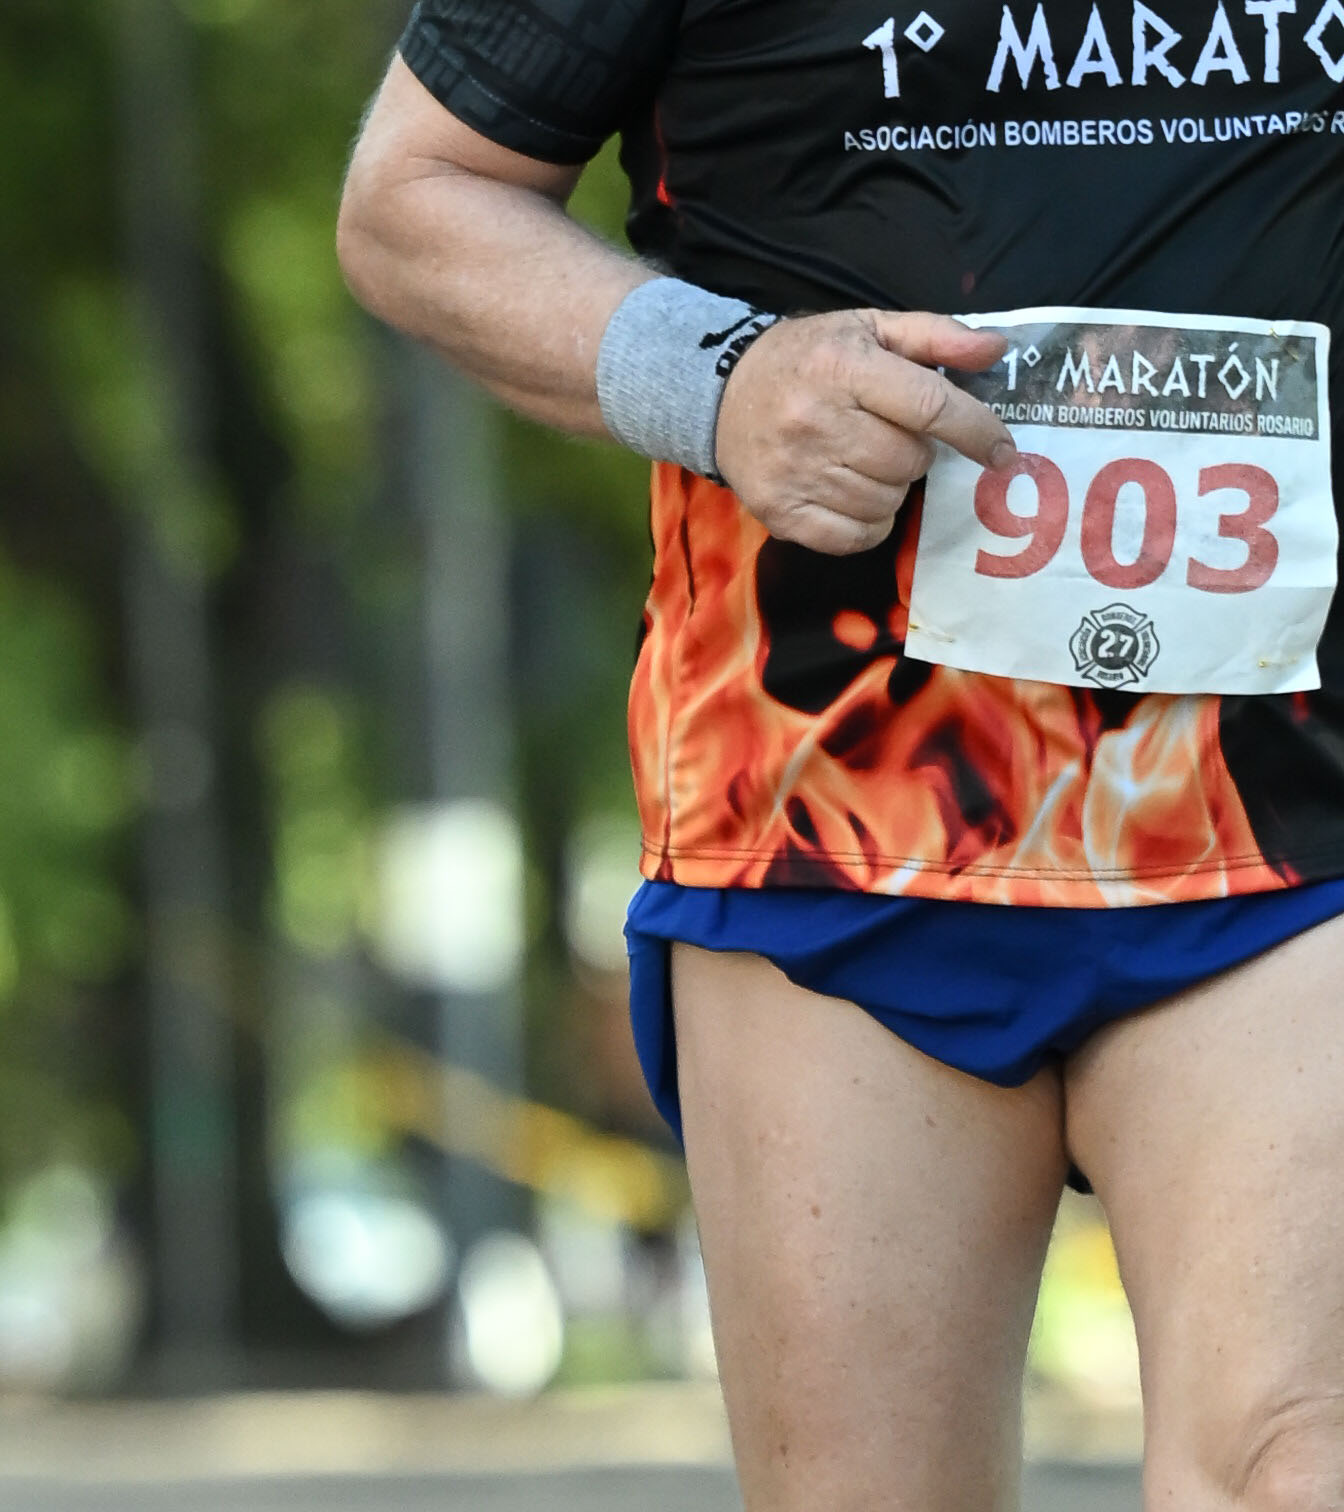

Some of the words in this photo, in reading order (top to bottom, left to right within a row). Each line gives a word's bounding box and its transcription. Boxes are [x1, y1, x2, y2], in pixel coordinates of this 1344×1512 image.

[844, 118, 996, 152] ASOCIACIÓN
[1004, 119, 1154, 148] BOMBEROS
[1056, 341, 1280, 402] MARATÓN
[1058, 405, 1145, 428] BOMBEROS
[1150, 410, 1254, 434] VOLUNTARIOS
[1256, 415, 1314, 437] ROSARIO
[973, 451, 1280, 594] 903
[1097, 628, 1135, 659] 27
